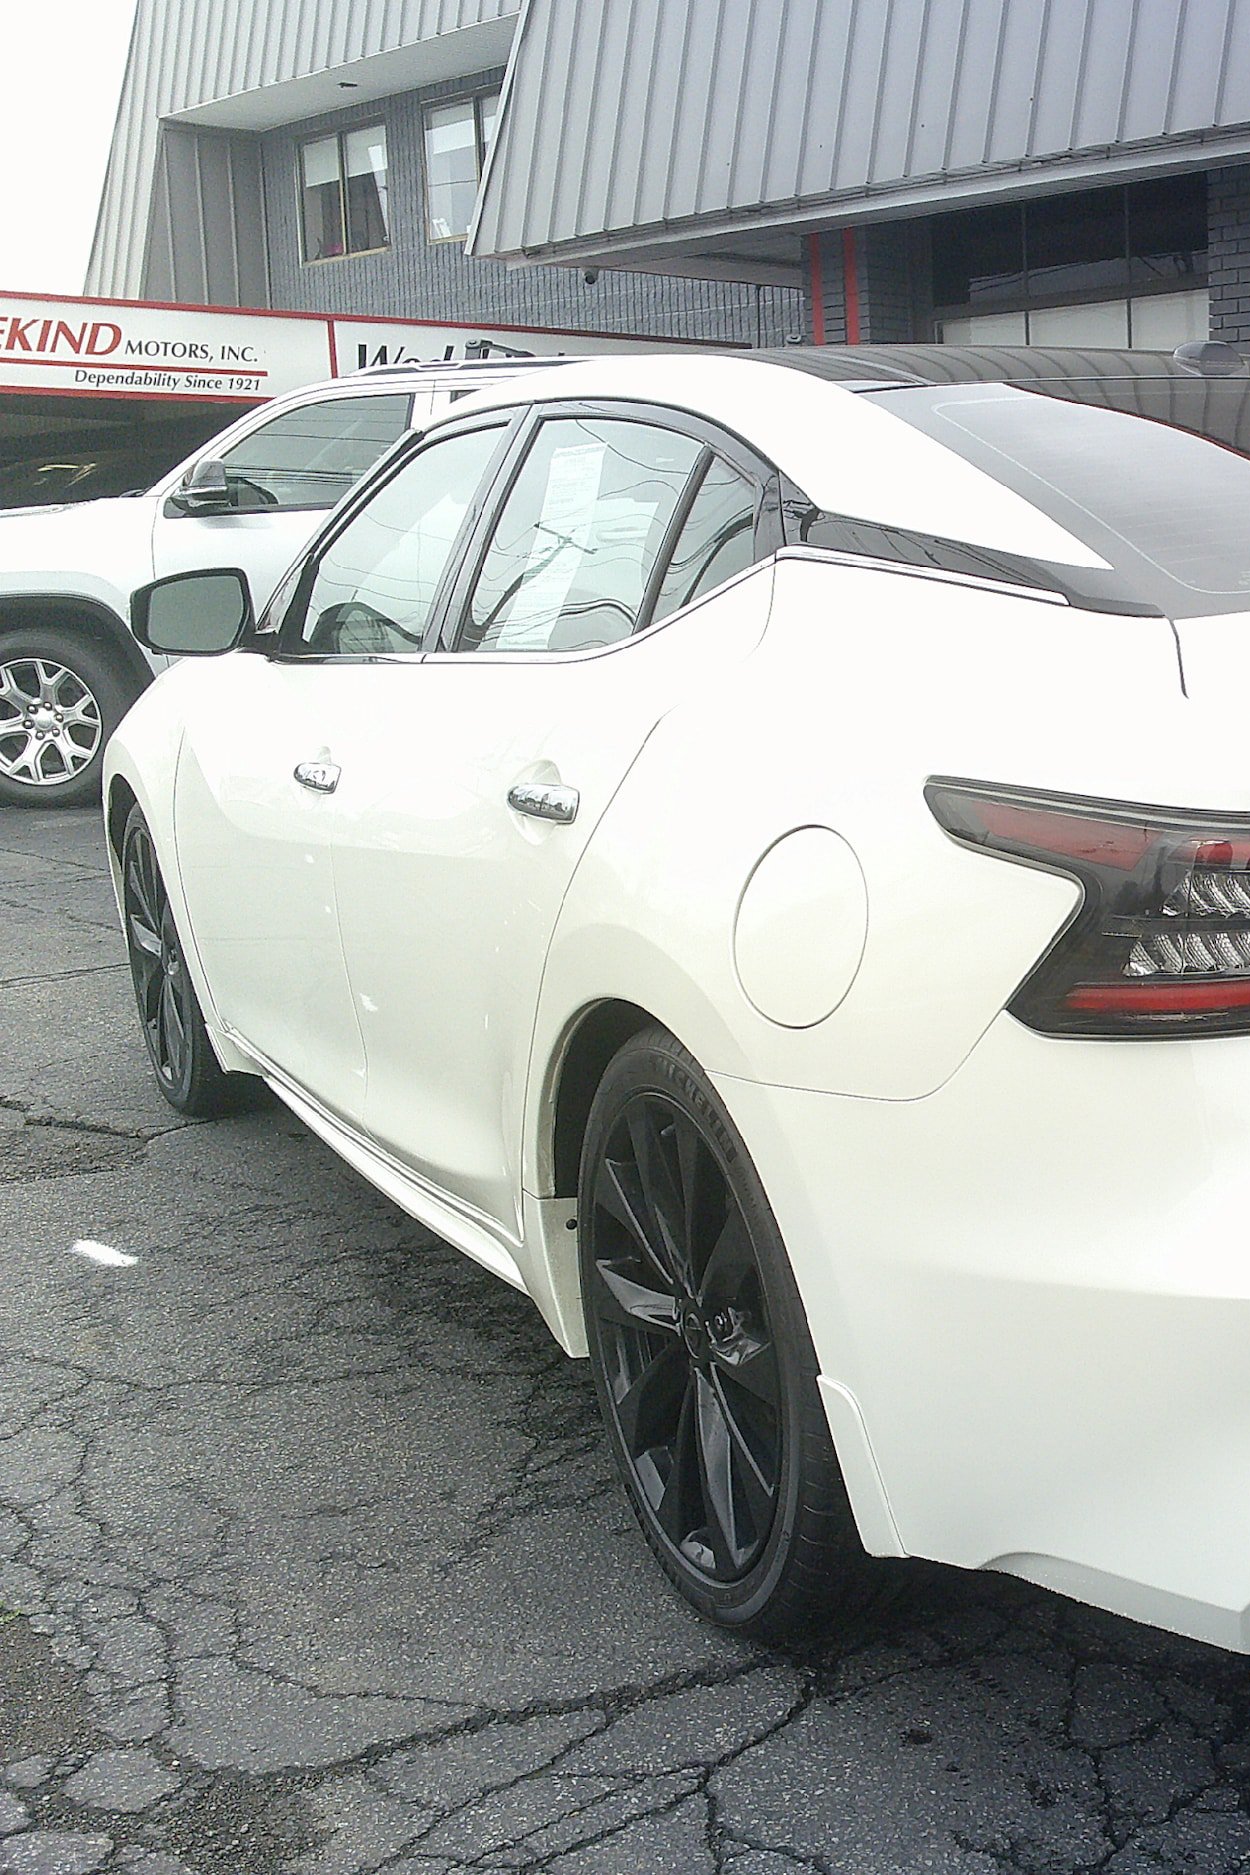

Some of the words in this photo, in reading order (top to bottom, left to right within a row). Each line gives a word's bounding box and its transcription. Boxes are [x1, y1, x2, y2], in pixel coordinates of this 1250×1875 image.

[124, 339, 214, 363] MOTORS,
[220, 345, 259, 363] INC.
[75, 369, 181, 392] Dependability
[184, 374, 223, 390] Since
[227, 376, 260, 391] 1921
